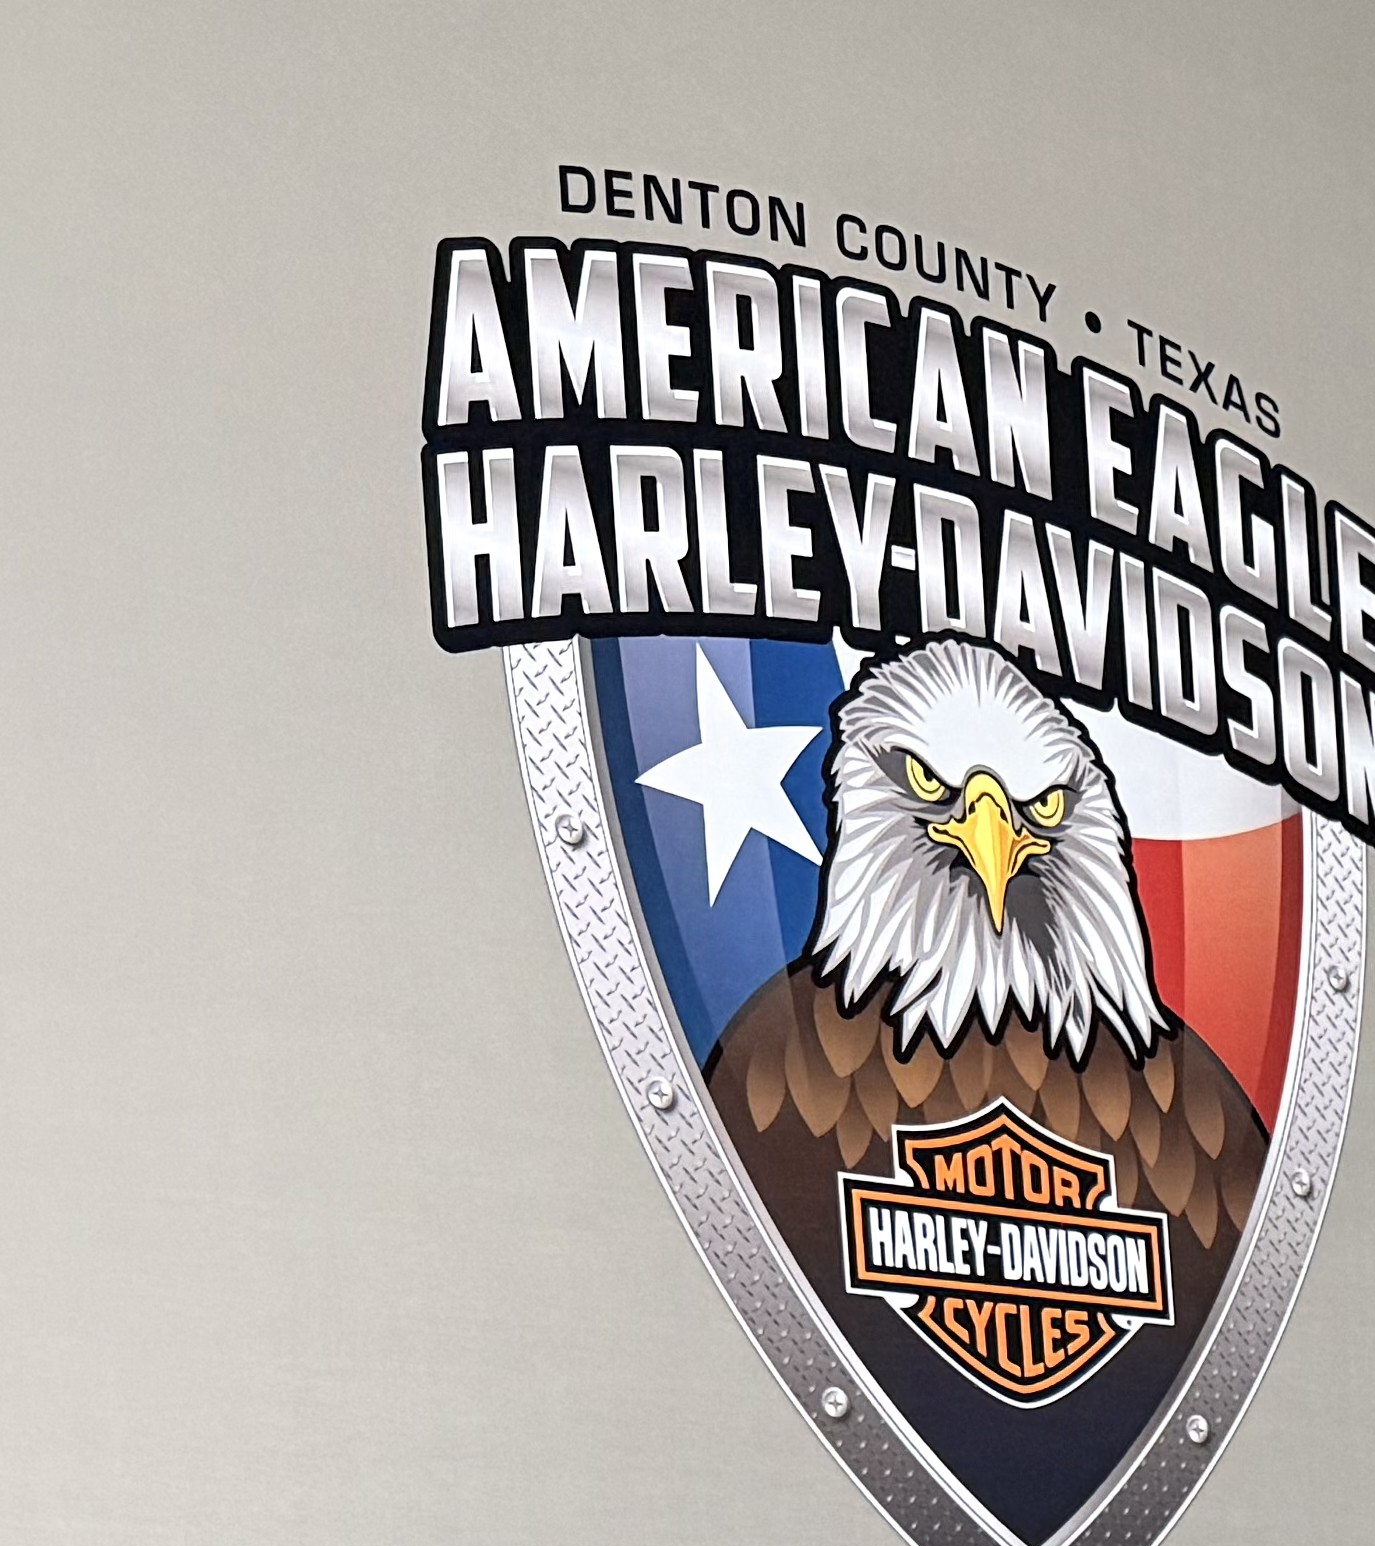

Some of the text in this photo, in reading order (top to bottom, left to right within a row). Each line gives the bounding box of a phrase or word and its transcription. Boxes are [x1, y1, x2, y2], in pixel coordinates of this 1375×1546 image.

[557, 163, 1283, 440] DENTON COUNTY TEXAS
[436, 246, 1054, 501] AMERICAN
[933, 1133, 1082, 1210] MOTOR
[867, 1205, 1150, 1294] HARLEY-DAVIDSON
[943, 1296, 1091, 1378] CYCLES
